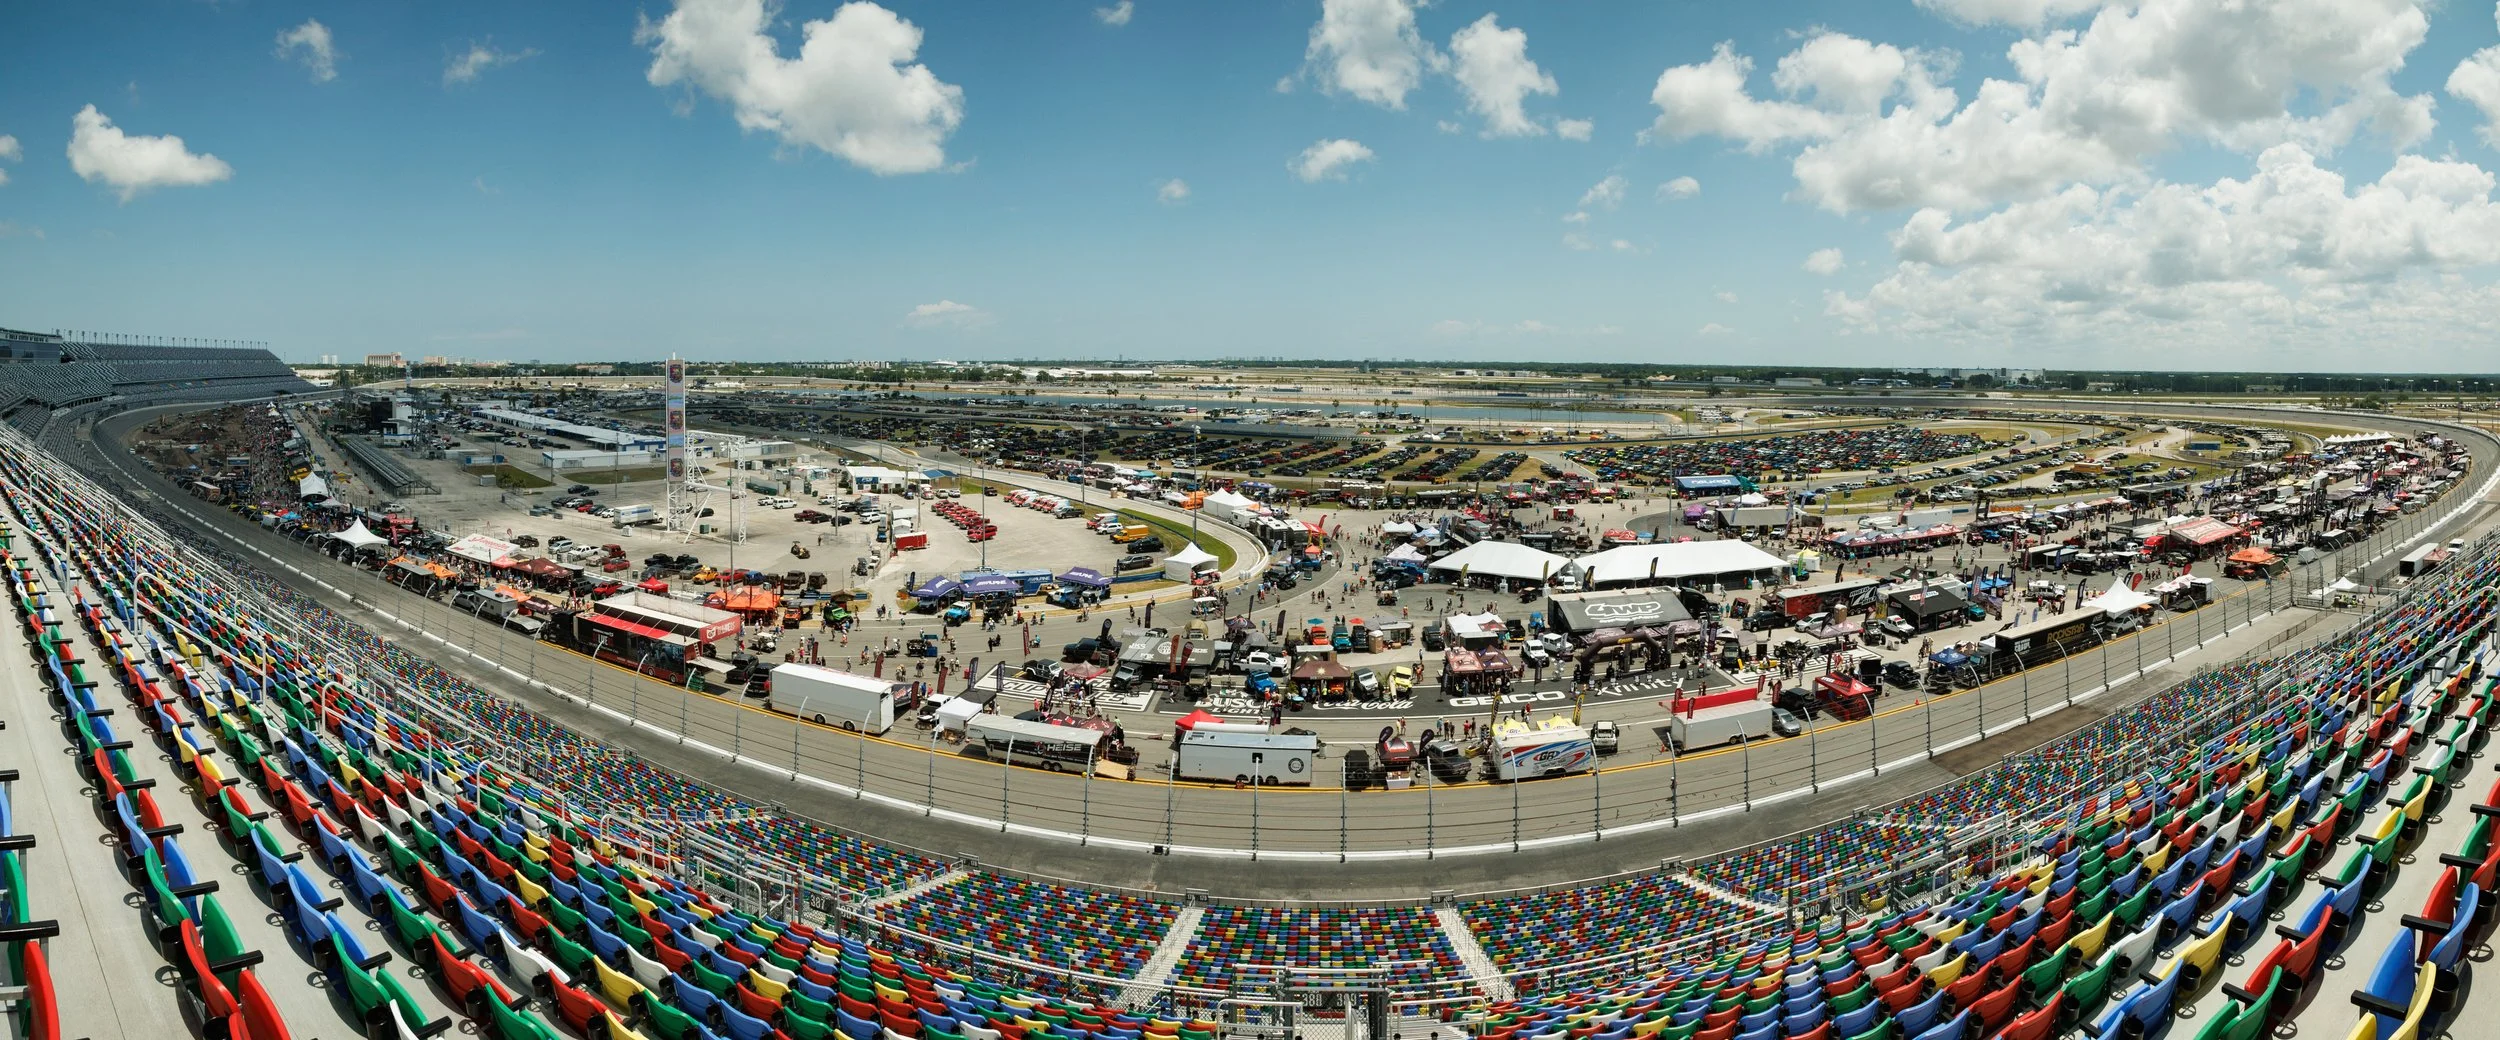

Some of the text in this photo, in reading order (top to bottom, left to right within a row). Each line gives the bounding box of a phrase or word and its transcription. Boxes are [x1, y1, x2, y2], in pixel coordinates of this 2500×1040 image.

[2047, 623, 2086, 643] ROCKSTAR
[1003, 681, 1046, 691] CUP
[1449, 691, 1565, 707] GEICO
[1046, 743, 1081, 752] HEISE
[810, 894, 826, 910] 387
[1804, 904, 1820, 919] 389
[1302, 993, 1322, 1007] 388
